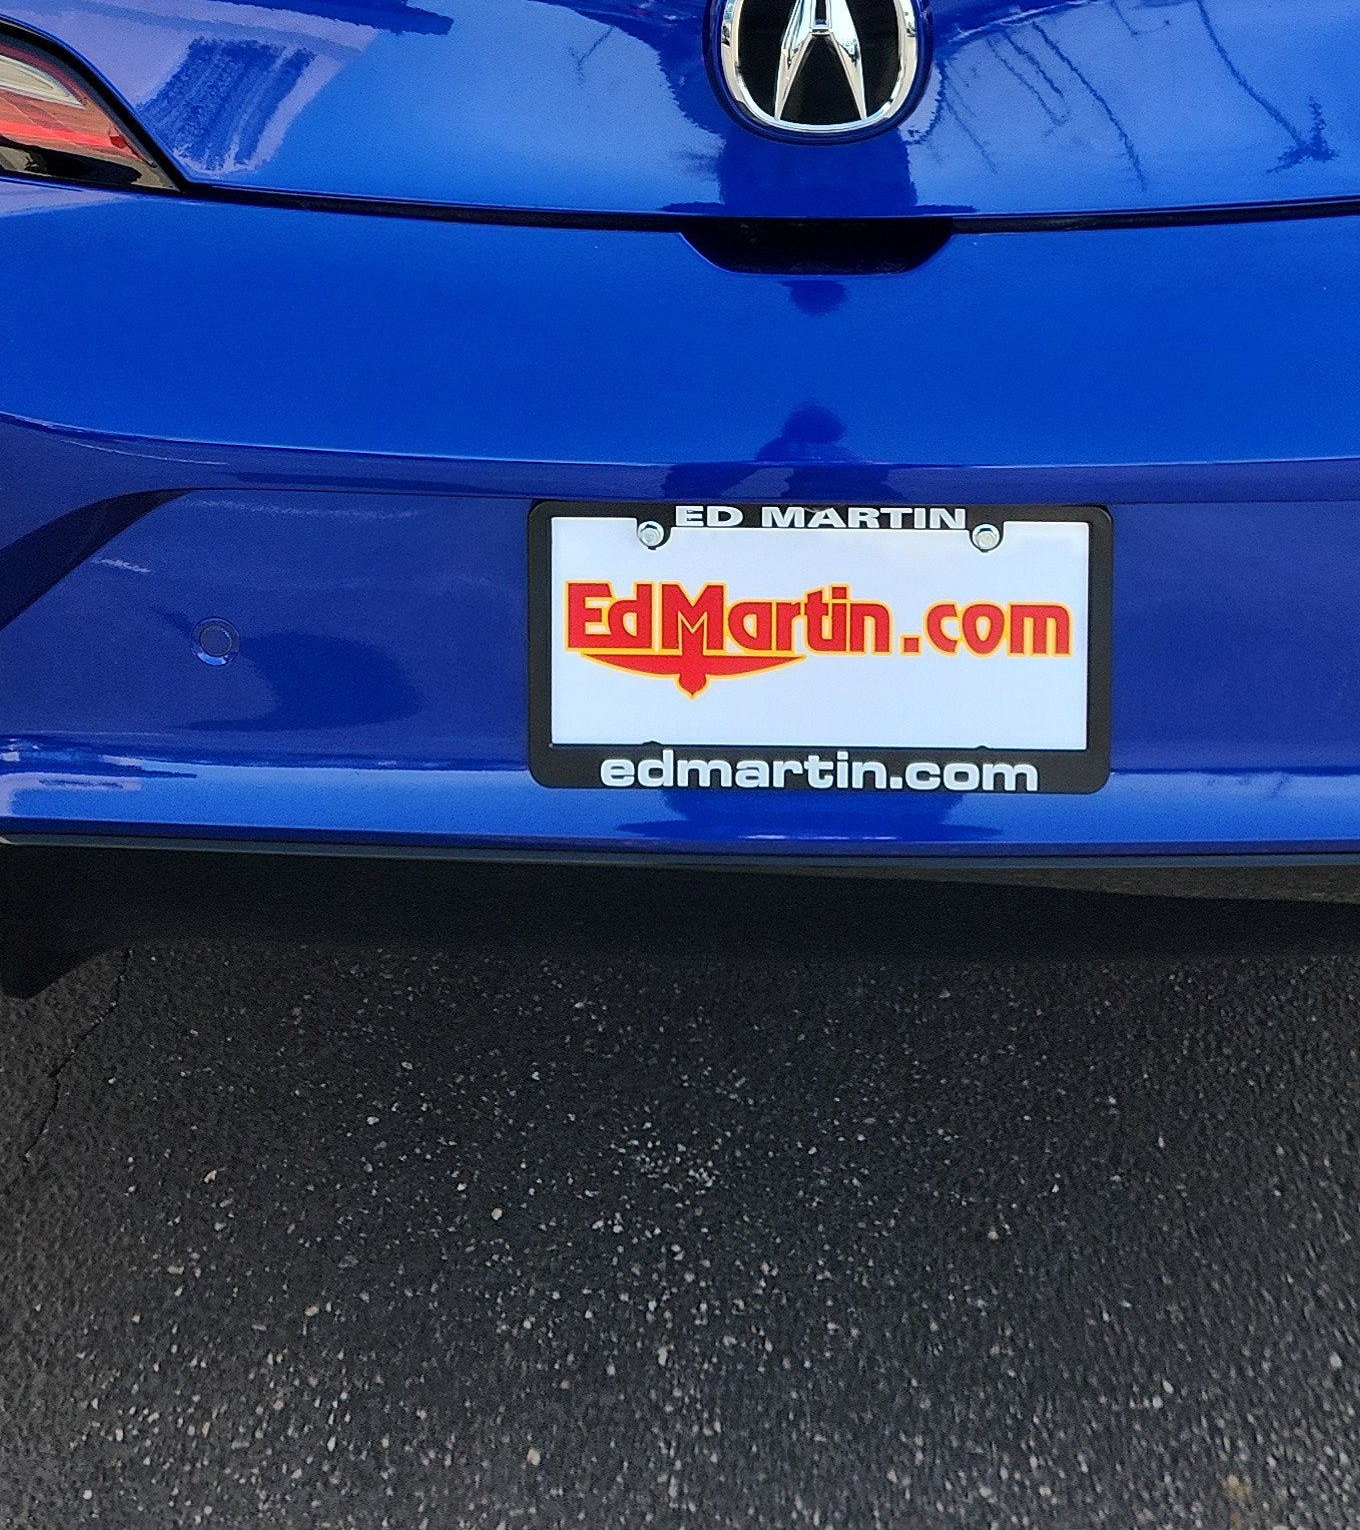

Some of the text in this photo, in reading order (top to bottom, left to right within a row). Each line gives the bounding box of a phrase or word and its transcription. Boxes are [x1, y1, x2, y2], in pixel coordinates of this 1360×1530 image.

[674, 504, 967, 530] ED MARTIN
[565, 580, 1072, 658] EdMartin.com
[600, 749, 1039, 792] edmartin.com
